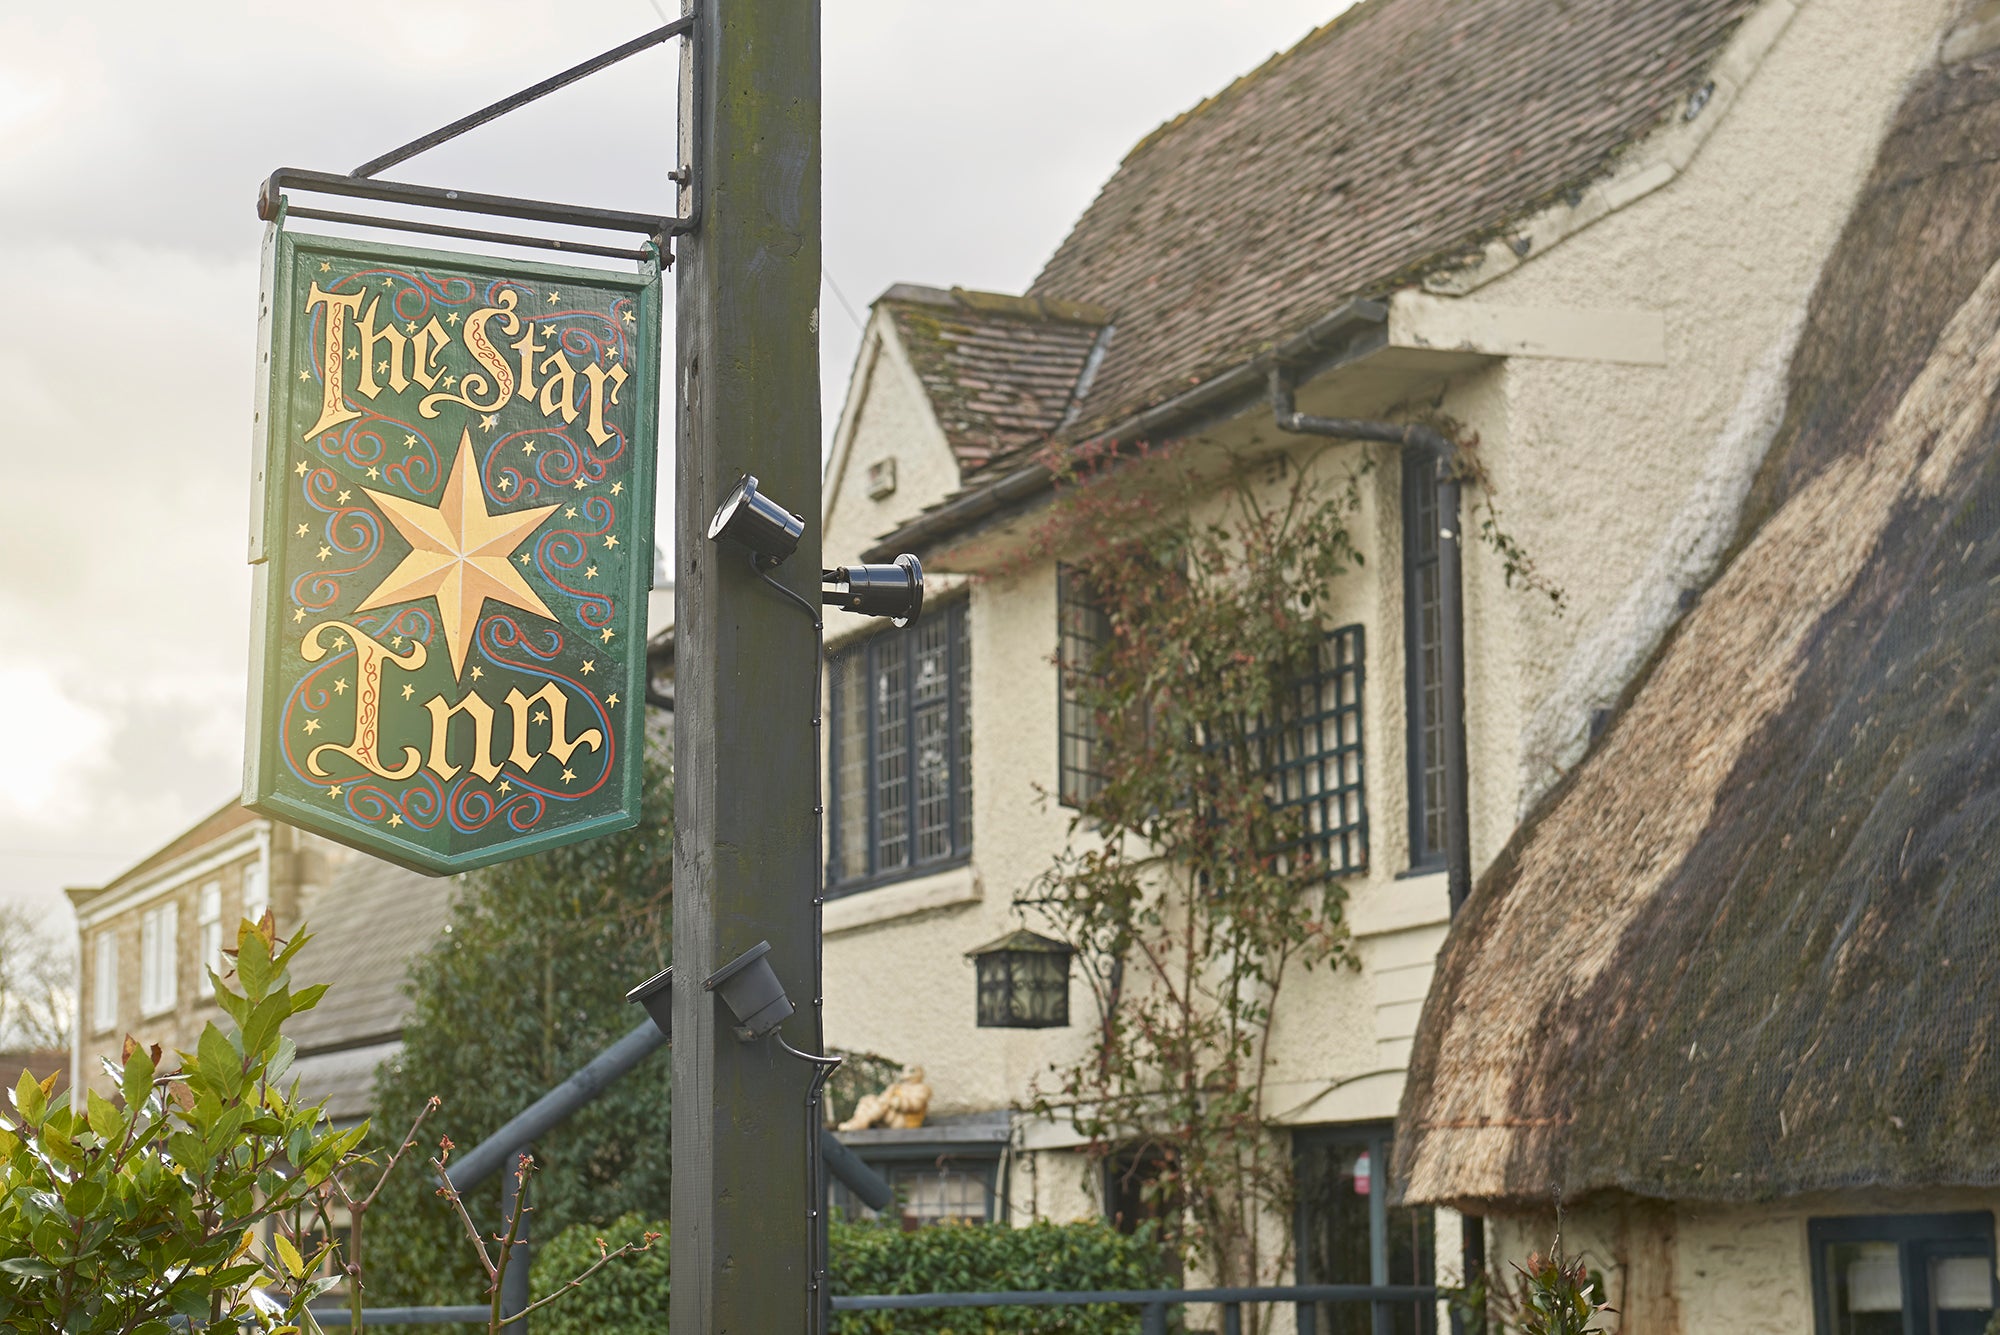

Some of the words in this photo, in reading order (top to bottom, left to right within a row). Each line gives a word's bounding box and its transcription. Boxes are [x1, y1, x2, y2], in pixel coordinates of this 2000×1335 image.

[304, 281, 451, 441] The
[418, 289, 629, 447] Star
[300, 621, 602, 783] Inn
